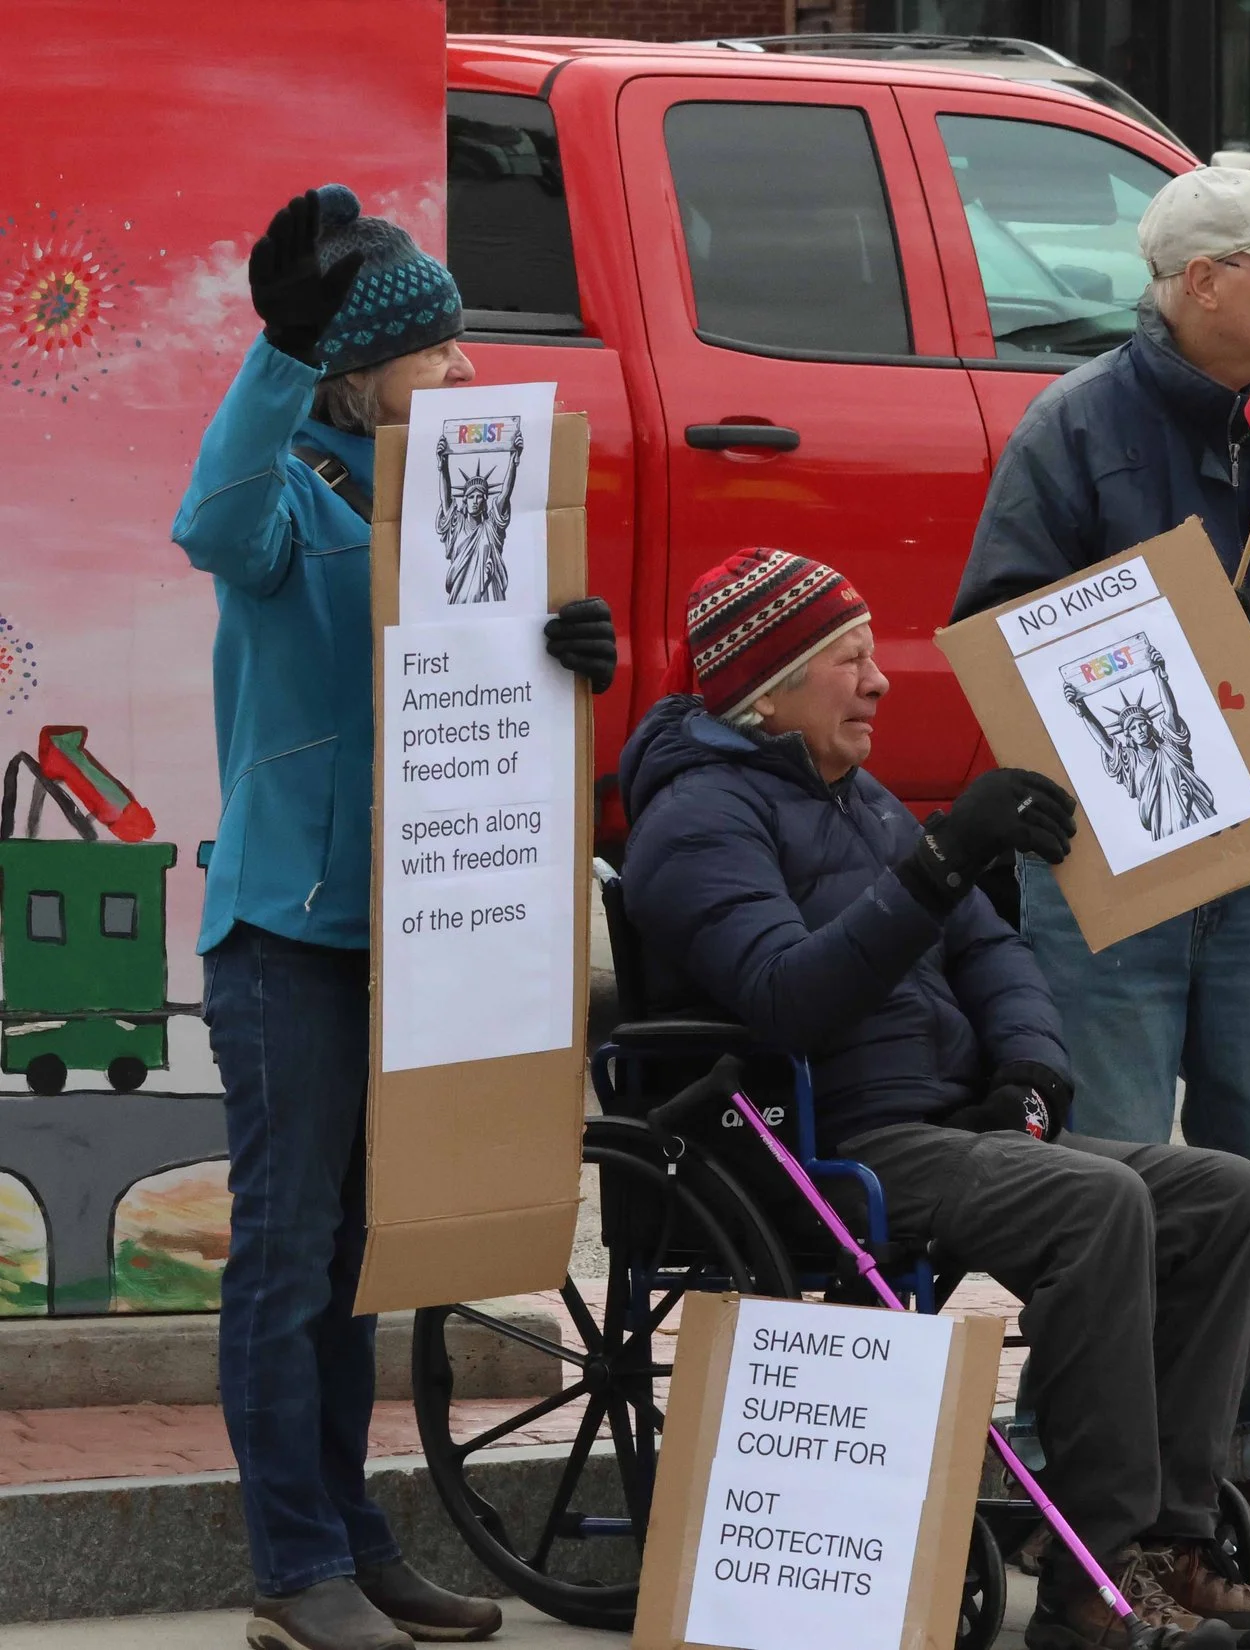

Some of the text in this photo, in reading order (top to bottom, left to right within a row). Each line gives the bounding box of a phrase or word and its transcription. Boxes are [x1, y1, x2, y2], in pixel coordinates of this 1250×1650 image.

[459, 422, 504, 444] RESIST
[1018, 569, 1137, 635] NO KINGS
[404, 653, 449, 675] First
[1080, 645, 1134, 684] RESIST
[403, 682, 531, 711] Amendment
[404, 717, 529, 752] protects the
[403, 751, 518, 782] freedom of
[402, 810, 540, 844] speech along
[402, 845, 536, 875] with freedom
[402, 903, 526, 933] of the press
[754, 1328, 890, 1361] SHAME ON
[749, 1363, 798, 1388] THE
[743, 1398, 867, 1429] SUPREME
[738, 1432, 887, 1466] COURT FOR
[726, 1489, 780, 1514] NOT
[721, 1524, 882, 1561] PROTECTING
[716, 1559, 872, 1595] OUR RIGHTS
